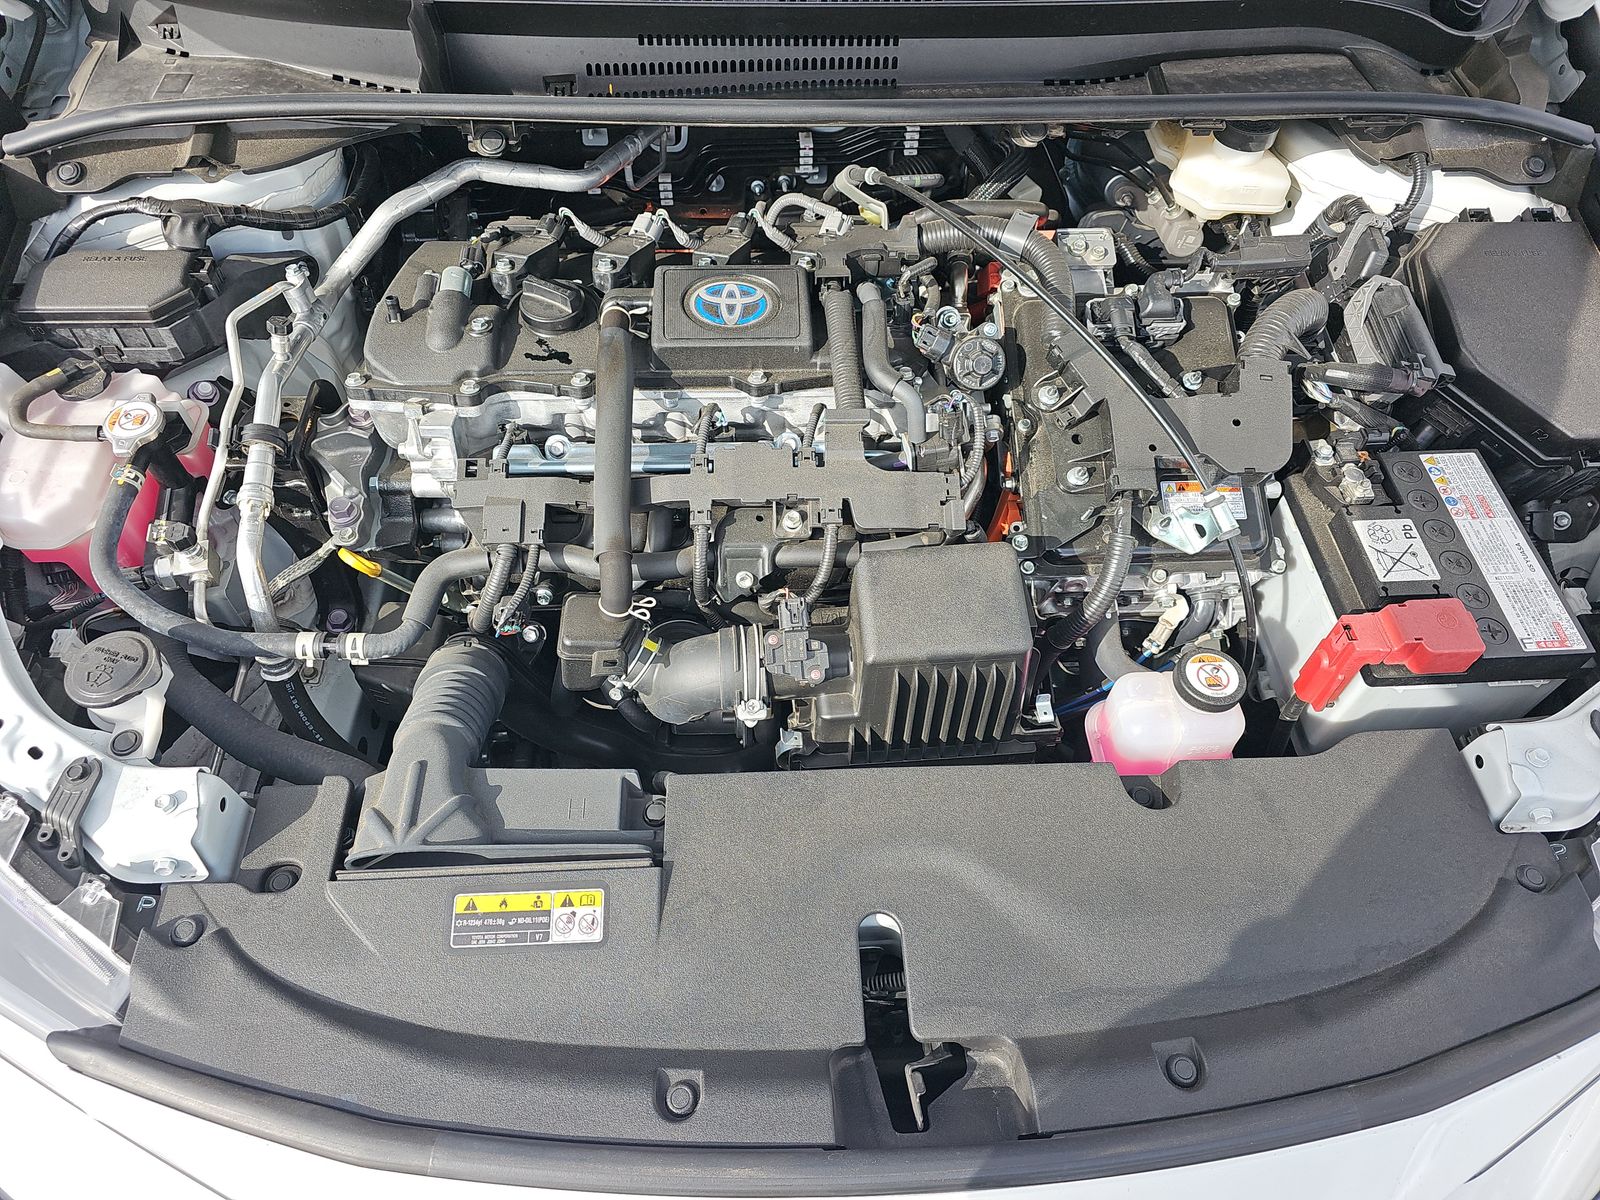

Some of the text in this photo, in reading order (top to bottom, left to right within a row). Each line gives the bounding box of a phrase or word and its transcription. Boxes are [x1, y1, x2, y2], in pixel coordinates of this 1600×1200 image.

[1401, 524, 1417, 540] Pb
[136, 895, 156, 912] P
[535, 933, 543, 942] V7
